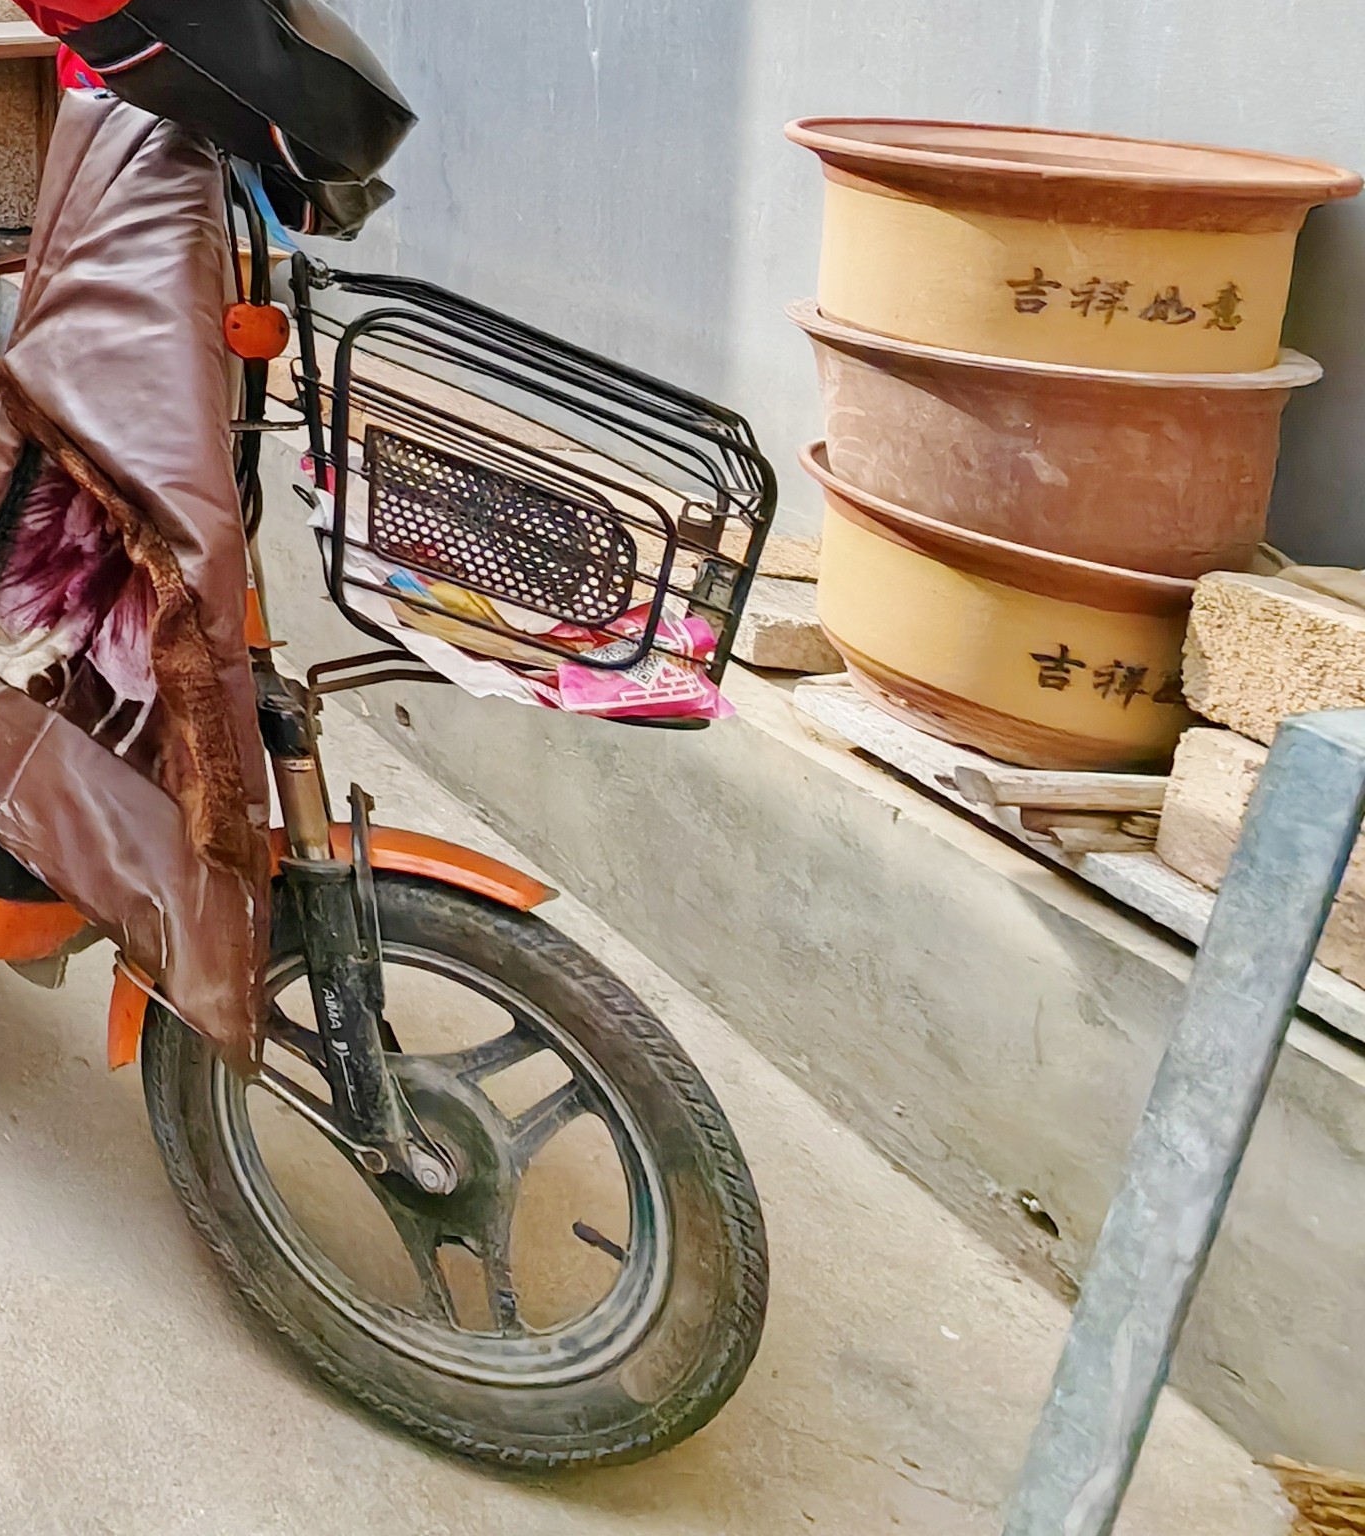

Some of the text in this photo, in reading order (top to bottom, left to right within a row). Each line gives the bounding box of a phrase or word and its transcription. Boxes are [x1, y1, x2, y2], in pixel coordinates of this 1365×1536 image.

[1005, 266, 1245, 331] 吉祥如意
[321, 987, 343, 1030] AIMA
